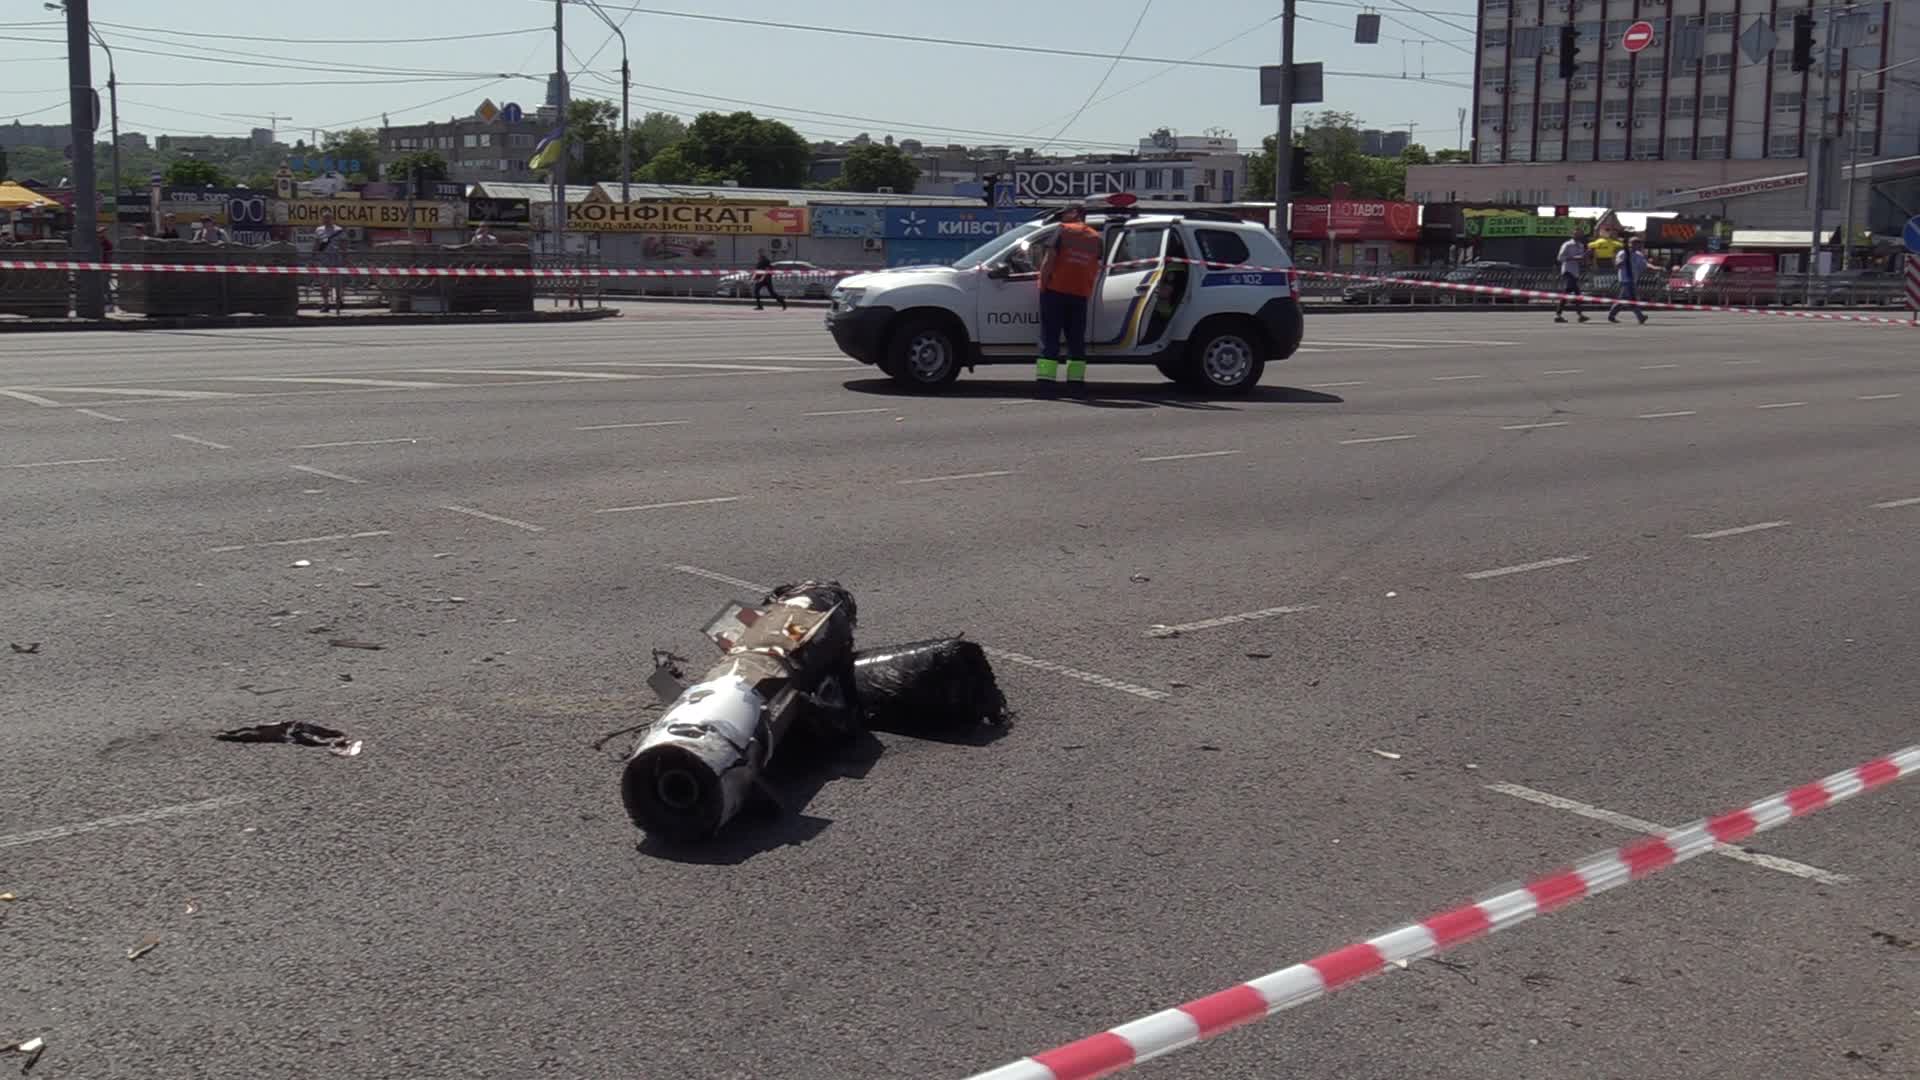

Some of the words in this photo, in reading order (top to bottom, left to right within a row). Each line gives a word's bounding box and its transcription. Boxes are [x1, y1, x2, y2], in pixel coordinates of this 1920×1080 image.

[1015, 171, 1125, 198] ROSHEN
[381, 206, 439, 223] ВЗУТТЯ
[567, 205, 756, 223] КОНФІСКАТ
[567, 221, 689, 232] СКЛАД-МАГАЗИН
[695, 224, 753, 232] ВЗУТТЯ
[1242, 274, 1263, 285] 102
[987, 312, 1041, 325] ПОЛІЦ
